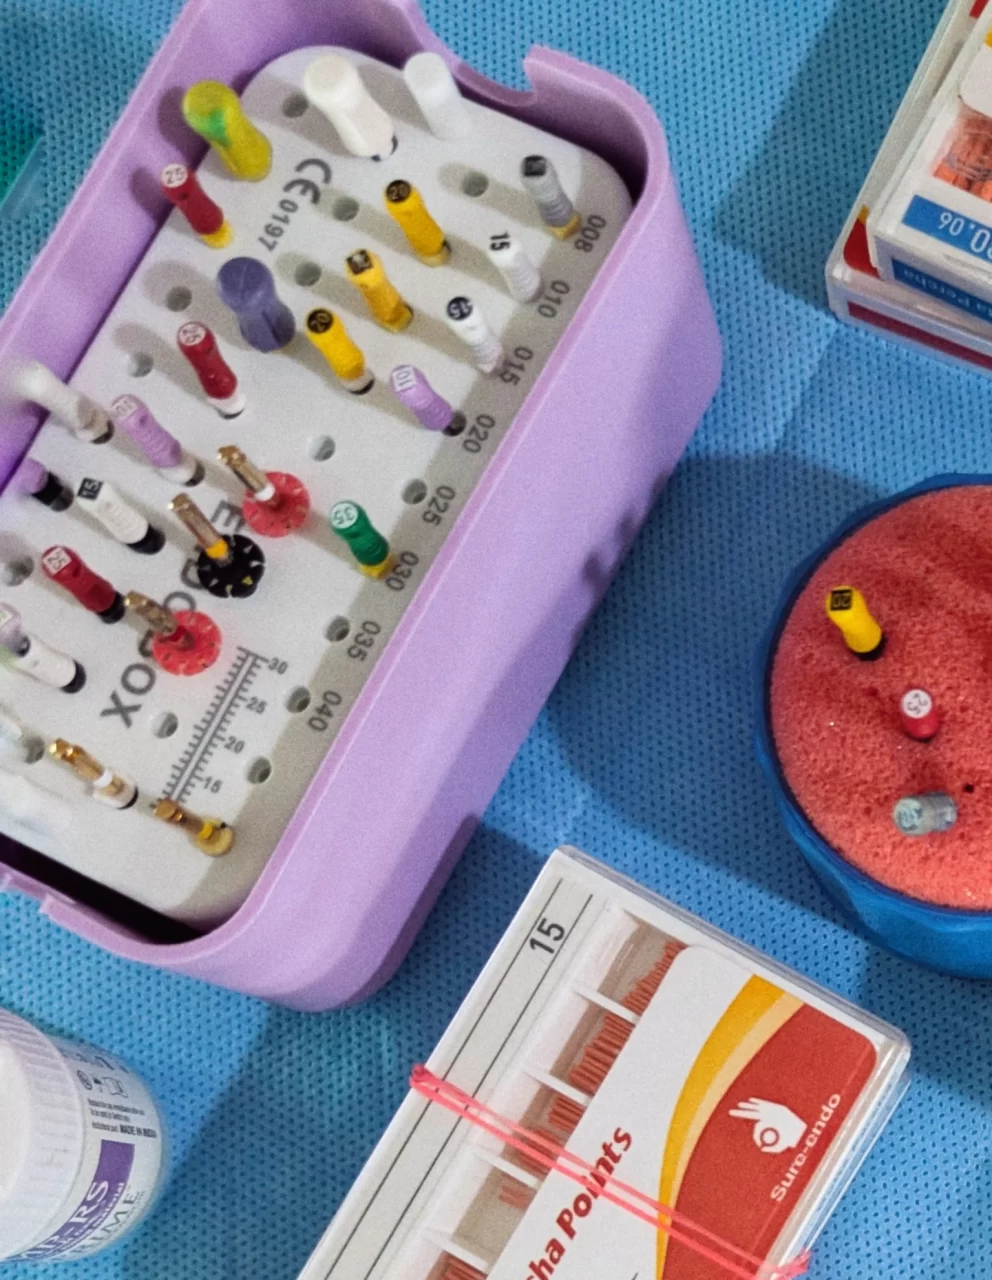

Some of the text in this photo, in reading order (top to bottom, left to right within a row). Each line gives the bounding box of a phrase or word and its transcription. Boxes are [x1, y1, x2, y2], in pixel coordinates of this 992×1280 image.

[258, 198, 298, 251] 0197
[488, 232, 511, 251] 15
[574, 214, 606, 256] 008
[537, 279, 570, 318] 010
[498, 346, 533, 385] 015
[462, 413, 496, 456] 020
[331, 502, 356, 527] 35
[421, 481, 455, 526] 025
[46, 551, 66, 571] 25
[385, 550, 419, 594] 030
[346, 620, 381, 661] 035
[267, 657, 288, 675] 30
[245, 696, 266, 714] 25
[307, 690, 342, 732] 040
[905, 692, 928, 716] 25
[224, 733, 245, 755] 20
[203, 776, 222, 793] 15
[529, 919, 565, 959] 15
[770, 1093, 841, 1202] Sure-endo
[556, 1128, 631, 1238] Points
